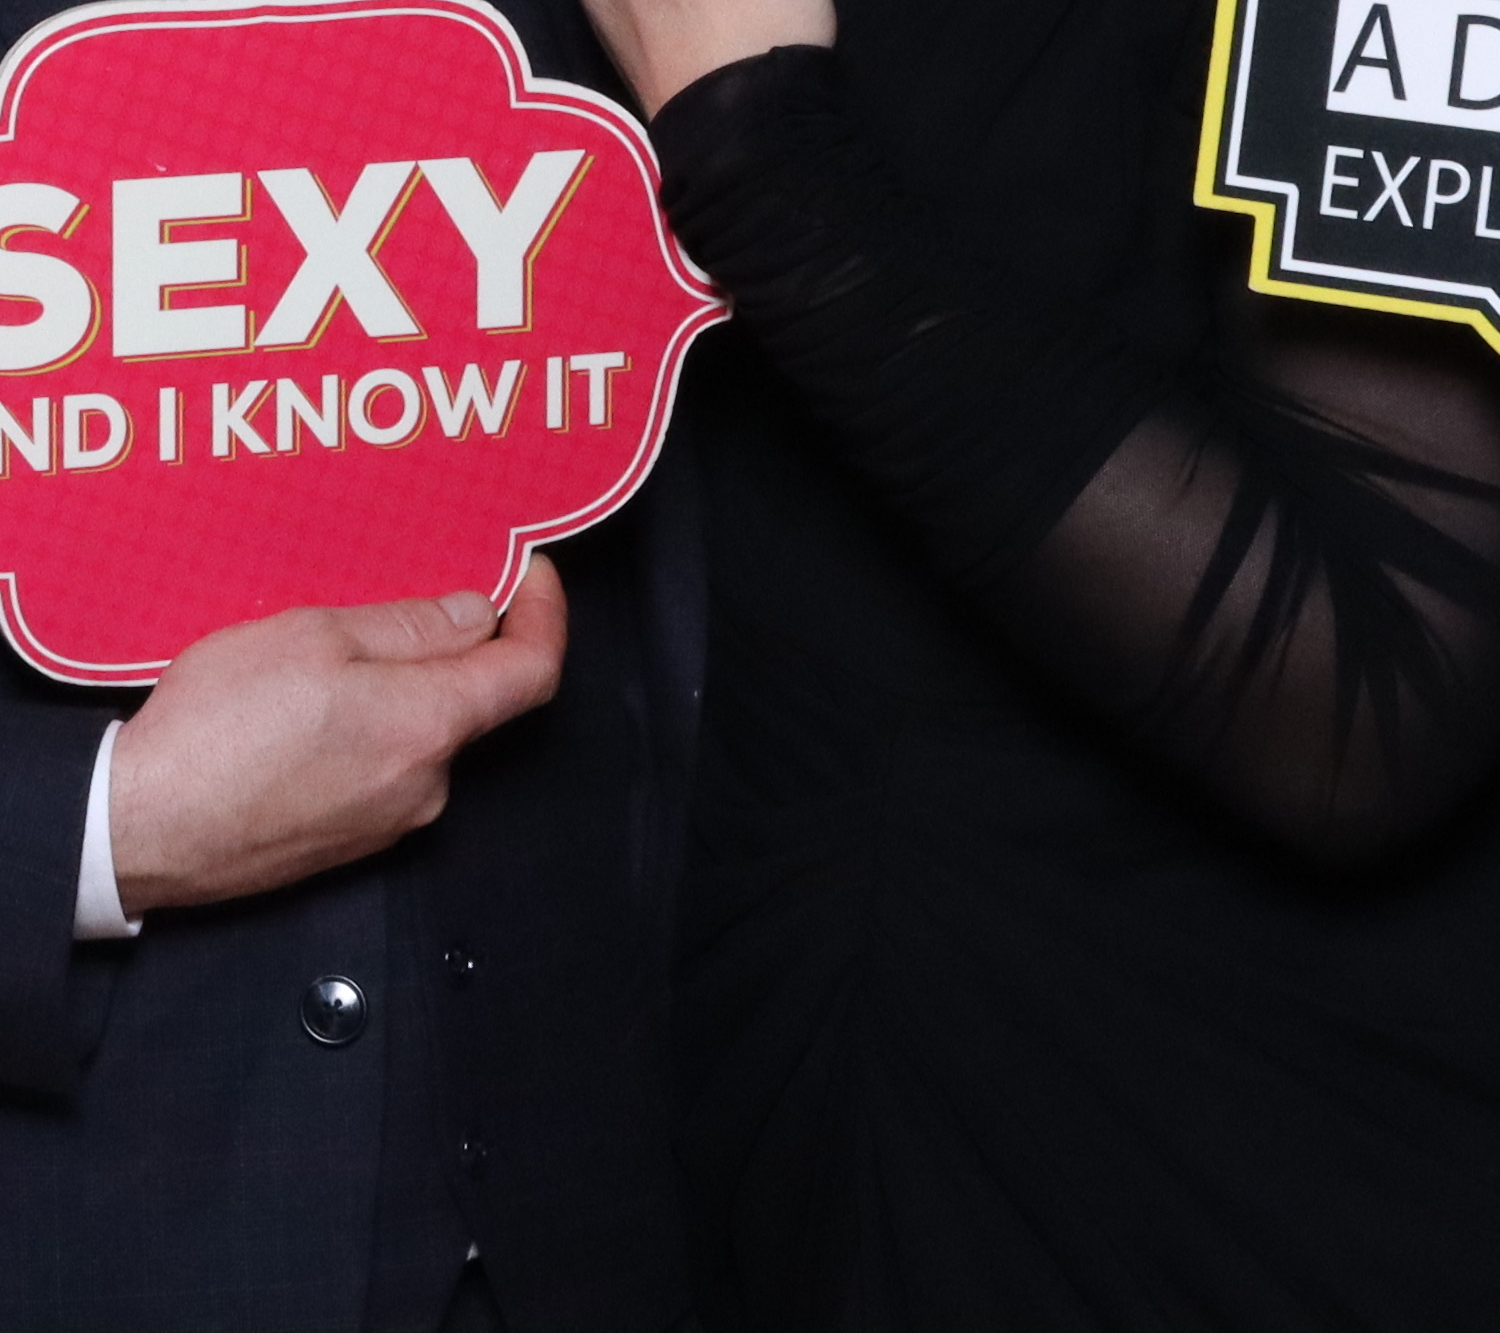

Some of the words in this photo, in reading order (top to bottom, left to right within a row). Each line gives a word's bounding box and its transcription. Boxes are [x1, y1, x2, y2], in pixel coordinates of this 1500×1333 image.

[158, 386, 183, 465] I
[211, 359, 527, 459] KNOW
[545, 351, 630, 432] IT
